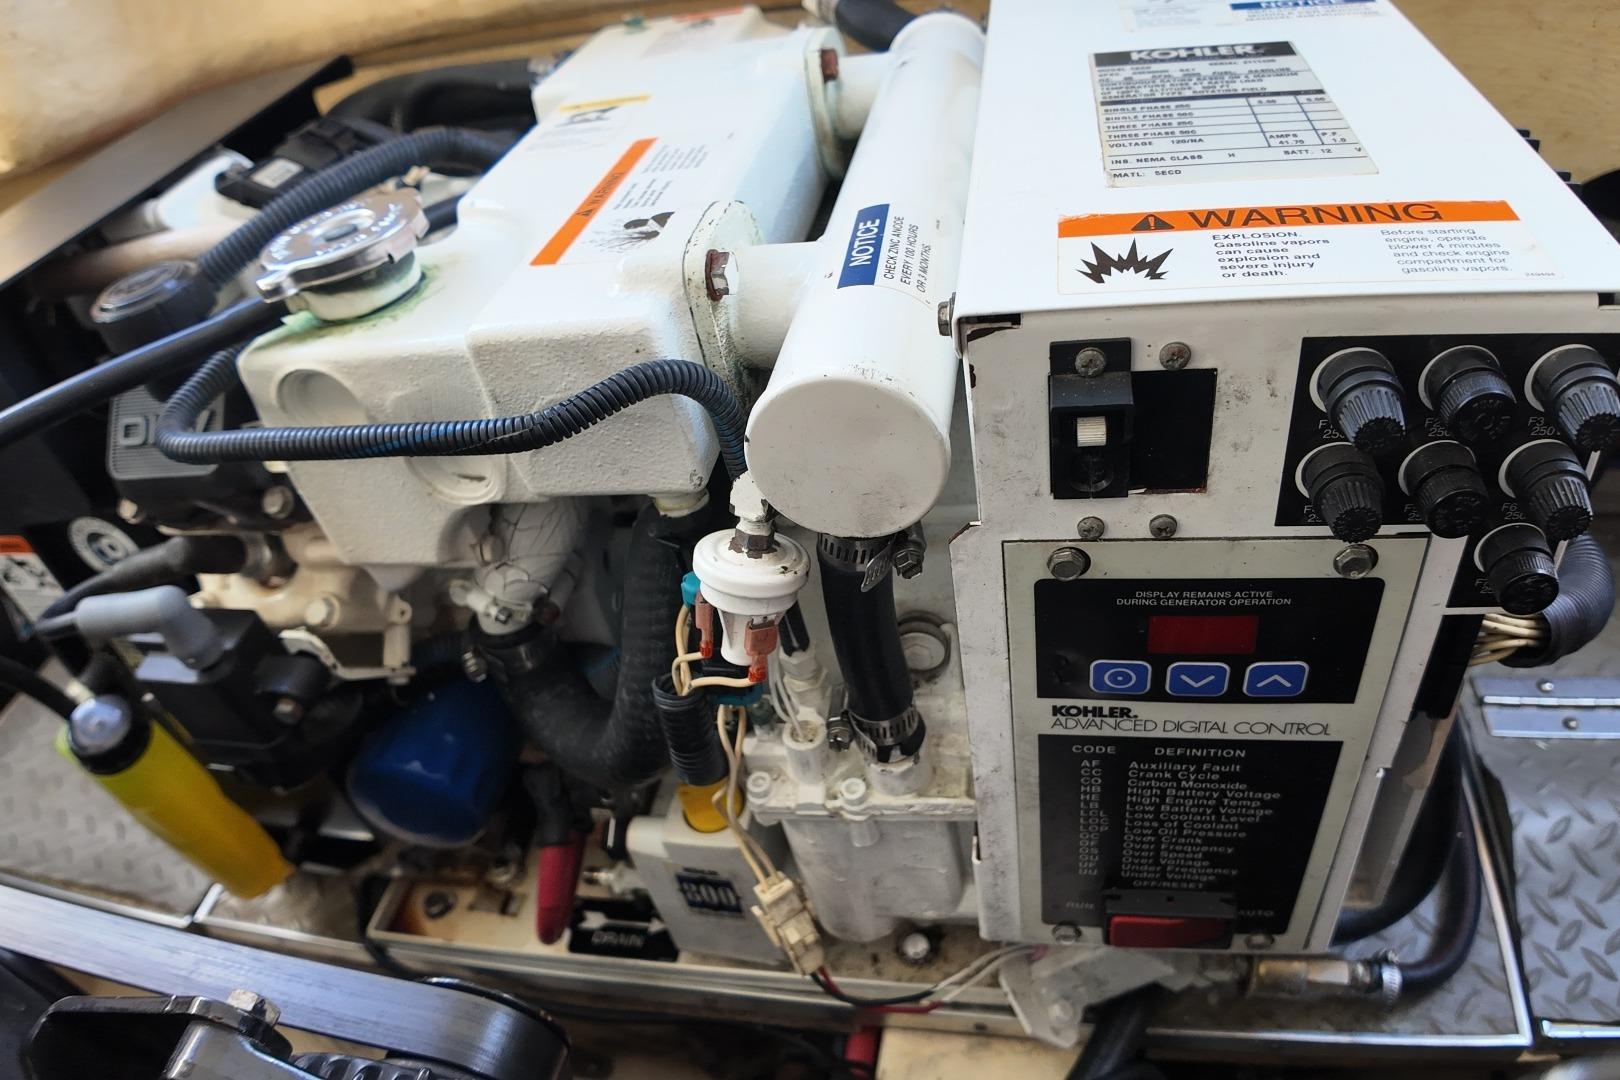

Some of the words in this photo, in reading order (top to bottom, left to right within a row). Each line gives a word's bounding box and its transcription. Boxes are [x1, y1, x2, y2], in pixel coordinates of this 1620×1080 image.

[1113, 171, 1146, 179] MATL:
[1187, 203, 1443, 229] WARNING
[891, 216, 905, 239] ANODE
[1428, 227, 1477, 236] starting
[907, 224, 919, 249] HOURS
[1212, 231, 1302, 241] EXPLOSION.
[1437, 234, 1487, 243] operate
[848, 218, 881, 267] NOTICE
[888, 238, 901, 256] ZINC
[1214, 240, 1277, 248] Gasoline
[1281, 238, 1331, 247] vapors
[1449, 241, 1501, 249] minutes
[904, 247, 916, 261] 100
[1217, 254, 1290, 263] explosion
[1422, 249, 1461, 257] check
[1465, 249, 1510, 258] engine
[917, 243, 932, 277] MONTHS
[1273, 261, 1316, 270] injury
[1396, 256, 1487, 266] compartment
[1488, 256, 1507, 264] for
[883, 254, 898, 280] CHECK
[900, 260, 914, 285] EVERY
[1401, 264, 1459, 274] gasoline
[1462, 264, 1513, 274] vapors.
[1221, 271, 1237, 279] or
[1242, 269, 1288, 278] death.
[916, 279, 927, 293] OR
[1528, 417, 1545, 427] F3
[1530, 426, 1561, 436] 250
[1501, 502, 1518, 512] F6
[1135, 591, 1180, 599] DISPLAY
[1182, 591, 1232, 599] REMAINS
[1234, 590, 1273, 599] ACTIVE
[1116, 598, 1158, 606] DURING
[1159, 598, 1228, 607] GENERATOR
[1229, 597, 1292, 606] OPERATION
[1050, 717, 1158, 732] ADVANCED
[1162, 720, 1229, 735] DIGITAL
[1234, 721, 1331, 736] CONTROL
[1072, 745, 1117, 754] CODE
[1154, 747, 1247, 758] DEFINITION
[1080, 768, 1102, 776] CC
[1129, 761, 1196, 772] Auxiliary
[1202, 762, 1241, 772] Fault
[1128, 769, 1172, 779] Crank
[1177, 771, 1220, 781] Cycle
[1080, 777, 1102, 785] CO
[1127, 778, 1177, 788] Carbon
[1181, 781, 1248, 790] Monoxide
[1080, 785, 1102, 793] HB
[1127, 787, 1161, 796] High
[1166, 789, 1220, 799] Battery
[1226, 790, 1281, 801] Voltage
[1080, 801, 1099, 809] LB
[1126, 795, 1160, 804] High
[1165, 797, 1217, 806] Engine
[1222, 799, 1261, 808] Temp
[1160, 805, 1214, 815] Battery
[1219, 807, 1274, 817] Voltage
[1160, 812, 1217, 822] Coolant
[1221, 814, 1261, 823] Level
[1125, 819, 1159, 827] Loss
[1164, 820, 1178, 828] of
[1183, 821, 1239, 830] Coolant
[1124, 826, 1153, 834] Low
[1158, 828, 1178, 836] Oil
[1182, 829, 1247, 838] Pressure
[1123, 834, 1157, 842] Over
[1161, 835, 1203, 844] Crank
[1123, 841, 1156, 850] Over
[1160, 843, 1234, 853] Frequency
[1122, 849, 1155, 857] Over
[1160, 851, 1203, 859] Speed
[1122, 856, 1154, 864] Over
[1159, 858, 1211, 867] Voltage
[1121, 863, 1162, 871] Under
[1166, 866, 1239, 876] Frequency
[1121, 870, 1161, 879] Under
[1166, 872, 1216, 882] Voltage
